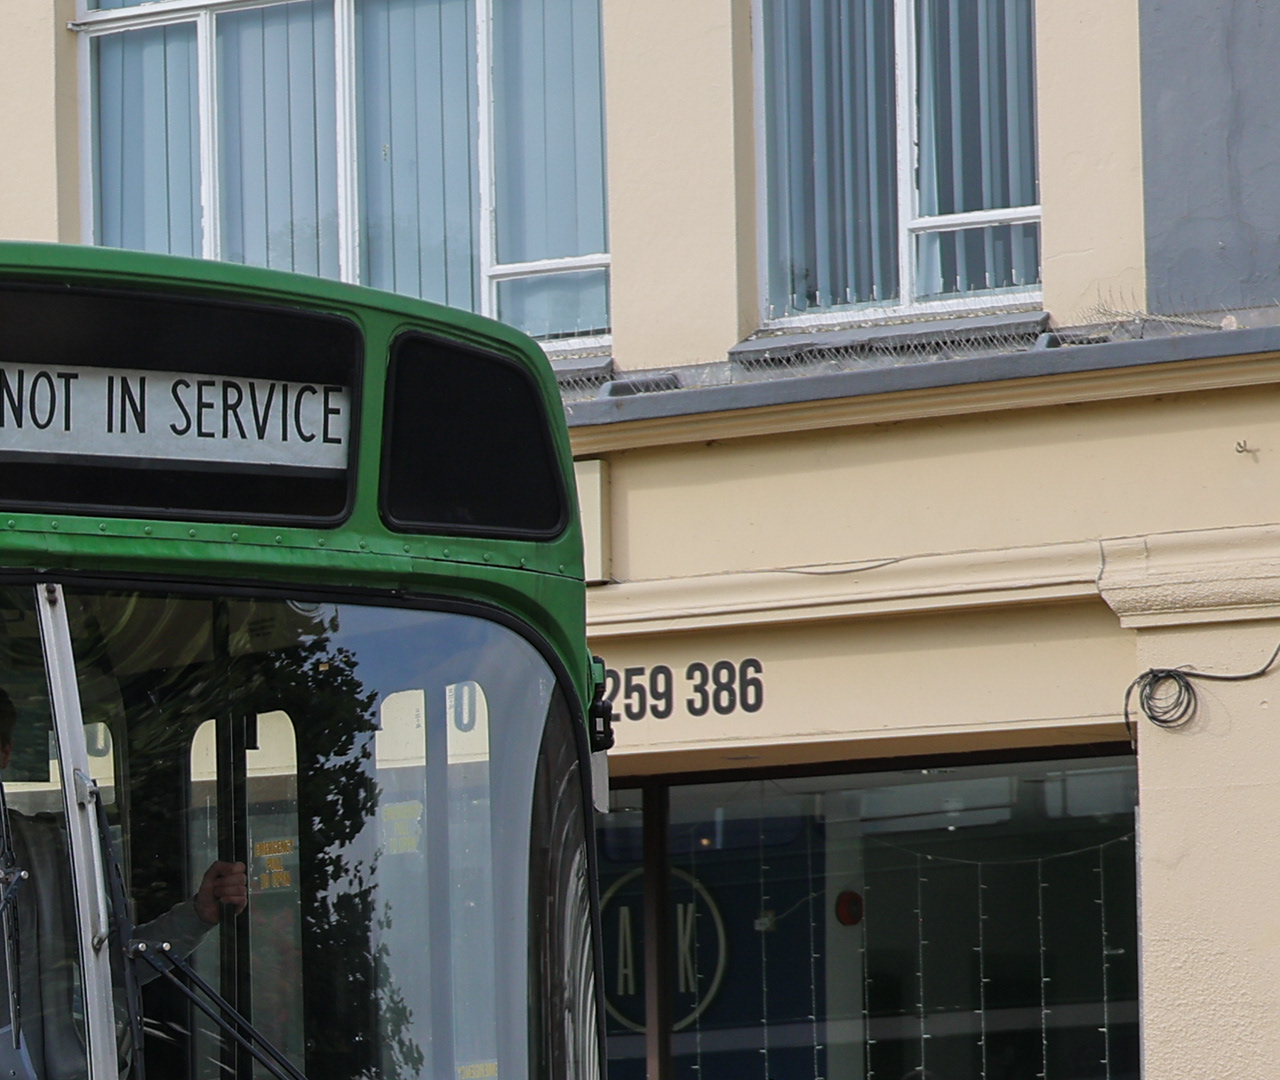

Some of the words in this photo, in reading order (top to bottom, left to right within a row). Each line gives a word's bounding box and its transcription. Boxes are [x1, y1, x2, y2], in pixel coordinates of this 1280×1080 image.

[107, 375, 147, 434] IN
[170, 379, 343, 444] SERVICE
[604, 665, 674, 723] 259
[686, 658, 763, 717] 386
